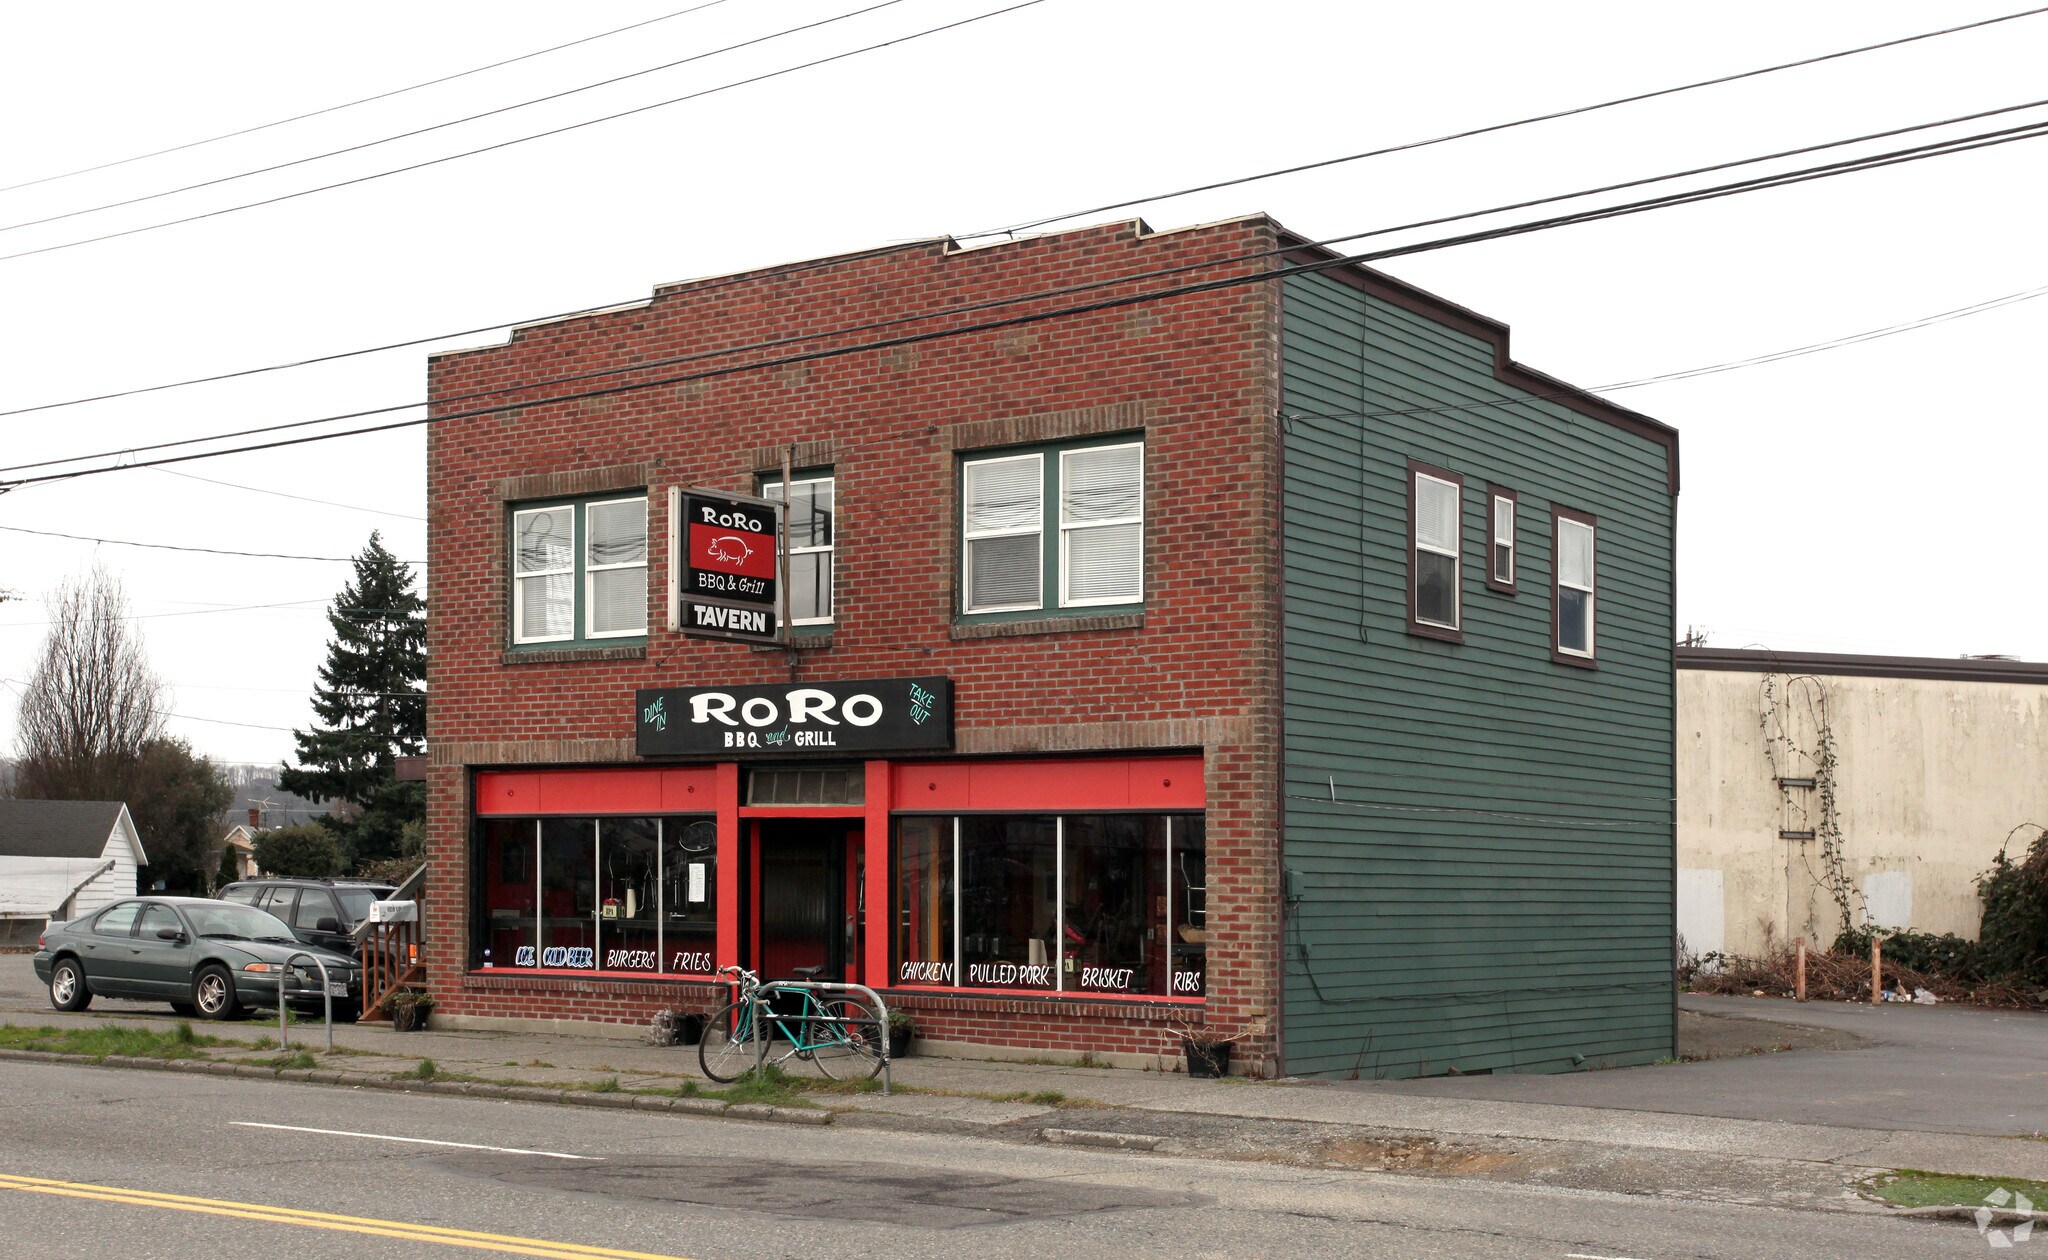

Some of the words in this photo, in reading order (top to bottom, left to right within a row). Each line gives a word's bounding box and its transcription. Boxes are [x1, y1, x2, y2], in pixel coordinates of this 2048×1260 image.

[702, 507, 762, 532] RoRo
[699, 573, 725, 591] BBQ
[727, 574, 736, 590] &
[739, 578, 765, 594] Grill
[694, 605, 766, 632] TAVERN
[909, 683, 936, 709] TAKE
[644, 696, 664, 723] DINE
[689, 689, 883, 727] RoRo
[910, 704, 931, 723] OUT
[656, 711, 667, 731] IN
[724, 731, 762, 748] BBQ
[766, 725, 790, 746] and
[794, 731, 836, 746] GRILL
[515, 946, 535, 966] ICE
[543, 947, 567, 966] COLD
[567, 947, 593, 968] BEER
[607, 950, 655, 968] BURGERS
[673, 952, 711, 972] FRIES
[901, 961, 953, 982] CHICKEN
[970, 964, 1017, 984] PULLED
[1019, 965, 1050, 986] PORK
[1081, 968, 1133, 989] BRISKET
[1173, 971, 1200, 992] RIBS
